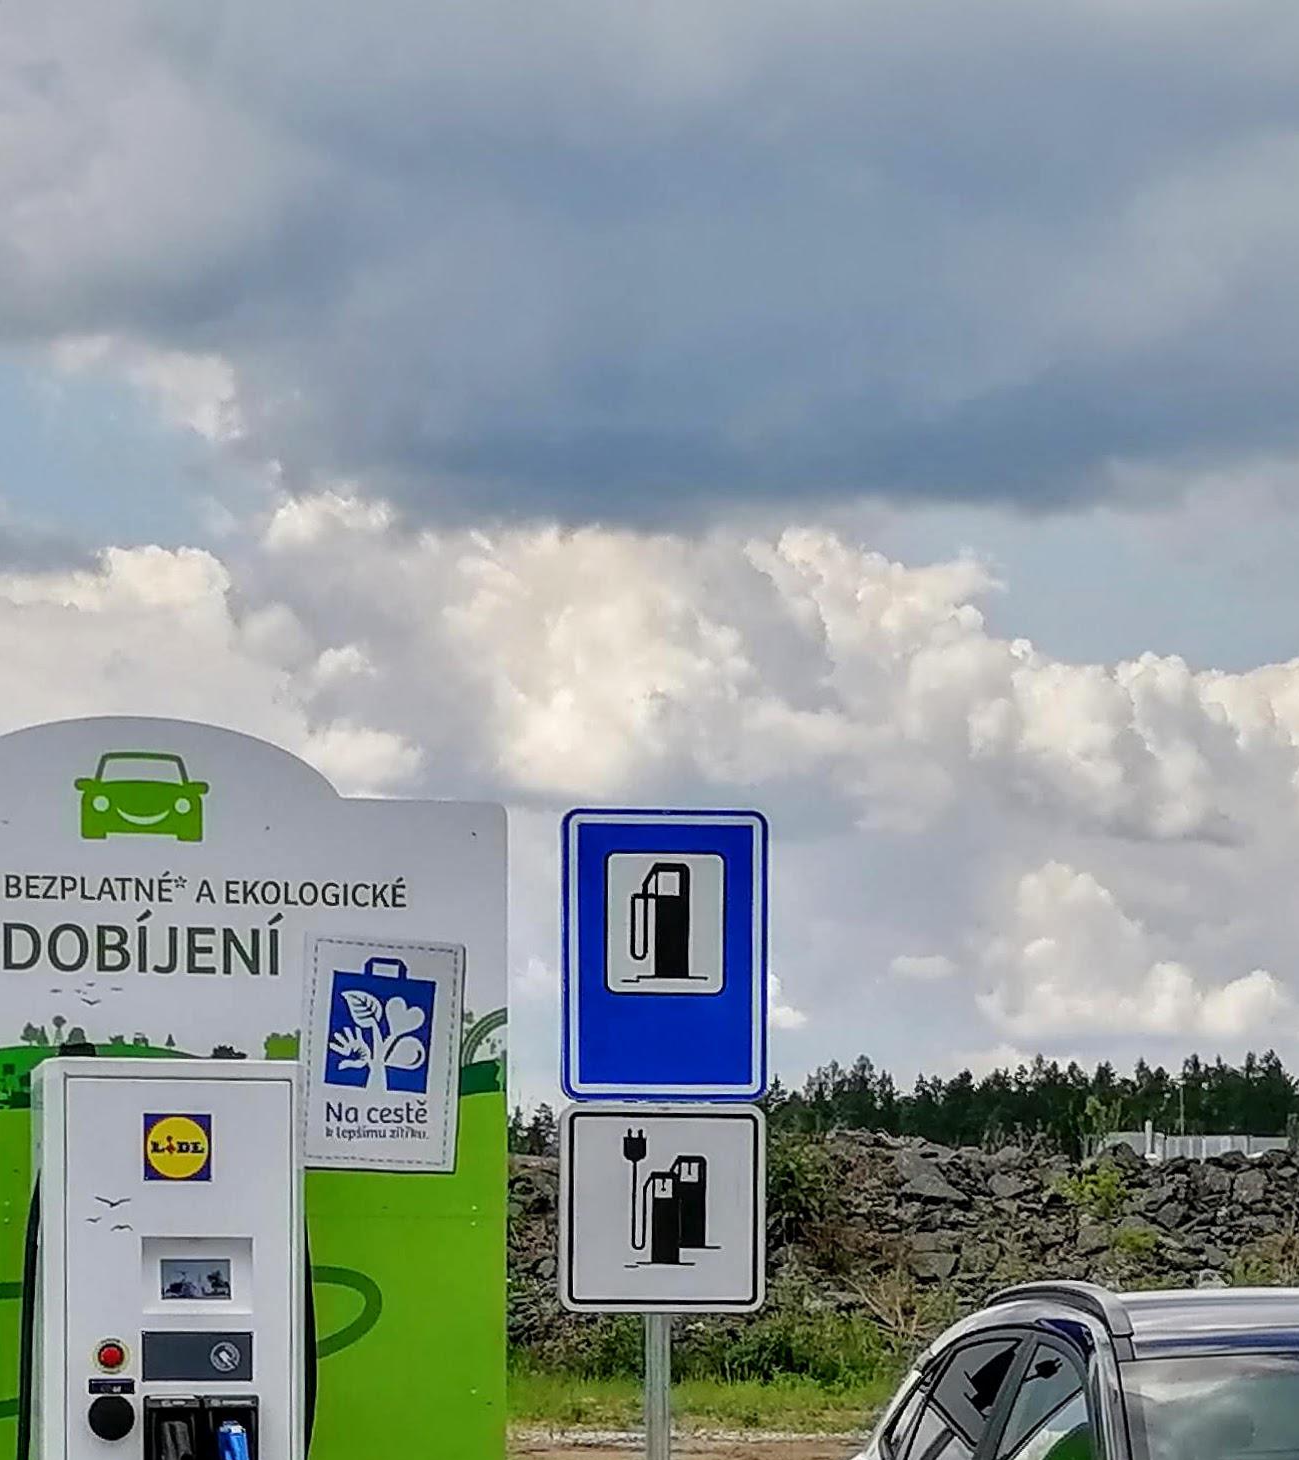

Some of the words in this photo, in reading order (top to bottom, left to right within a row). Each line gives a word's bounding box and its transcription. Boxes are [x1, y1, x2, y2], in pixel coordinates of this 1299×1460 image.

[195, 880, 216, 904] A
[224, 877, 407, 908] EKOLOGICKÉ
[3, 909, 284, 976] DOBÍJENÍ
[326, 1101, 359, 1122] Na
[367, 1099, 428, 1124] cestě
